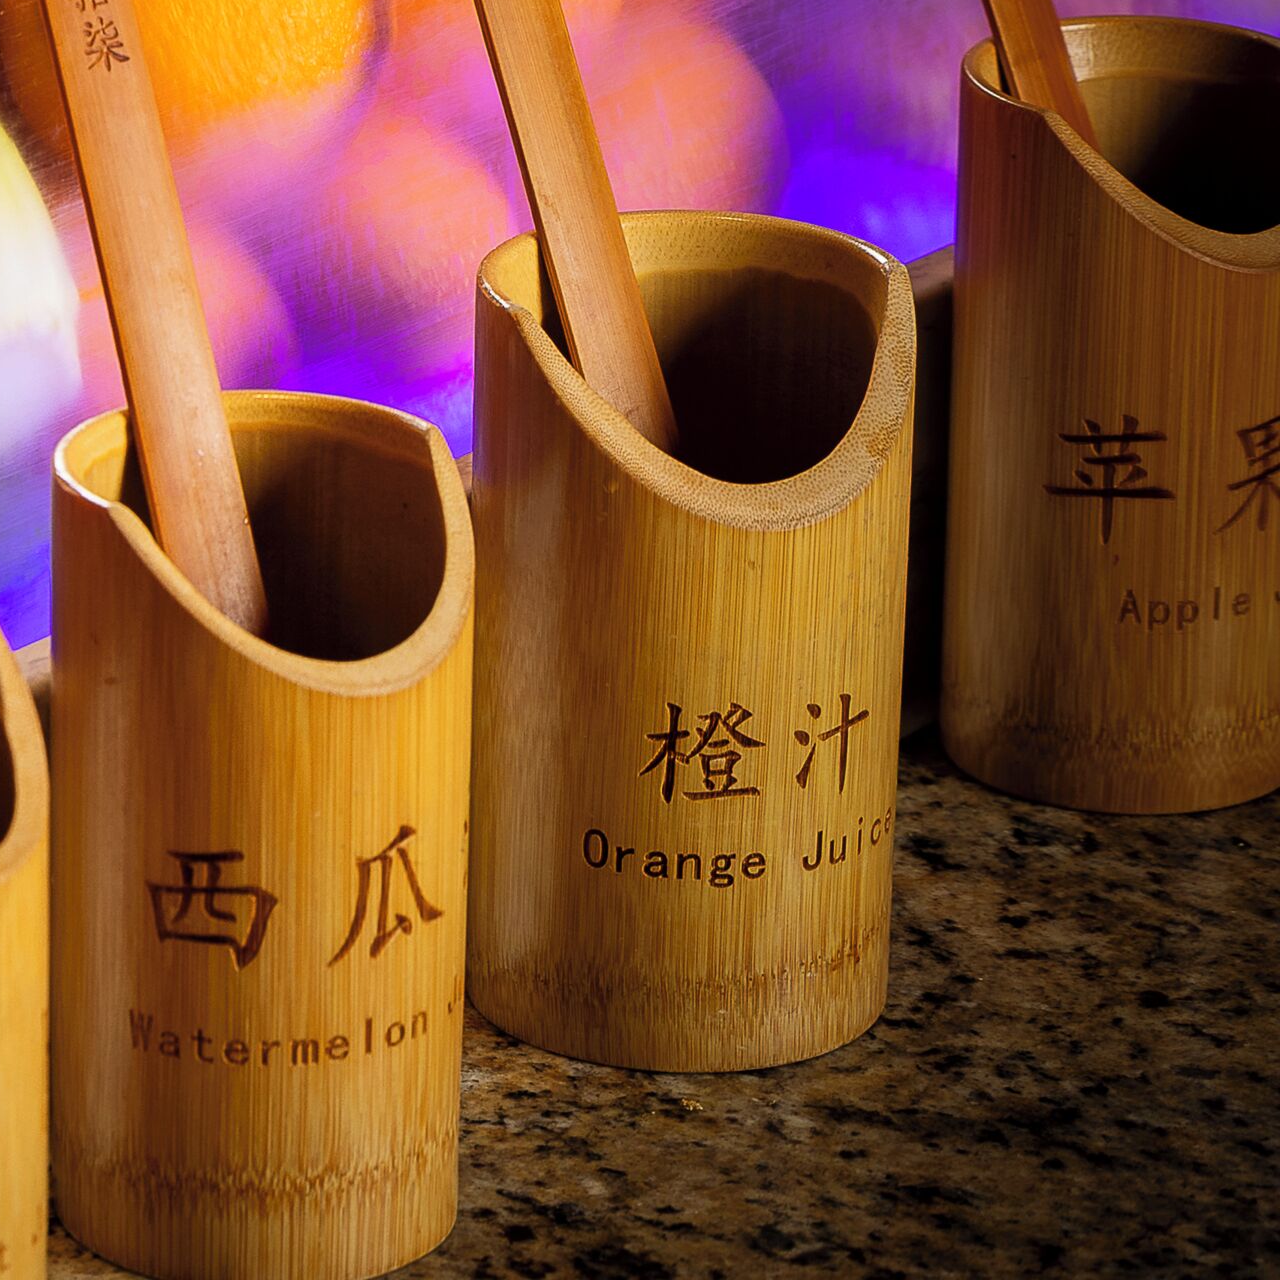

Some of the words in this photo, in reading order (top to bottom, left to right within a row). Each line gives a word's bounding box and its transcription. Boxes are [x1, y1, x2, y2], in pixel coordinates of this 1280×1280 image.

[1118, 587, 1253, 632] Apple
[640, 693, 871, 804] 橙汁
[582, 828, 768, 889] Orange
[129, 1007, 429, 1067] Watermelon
